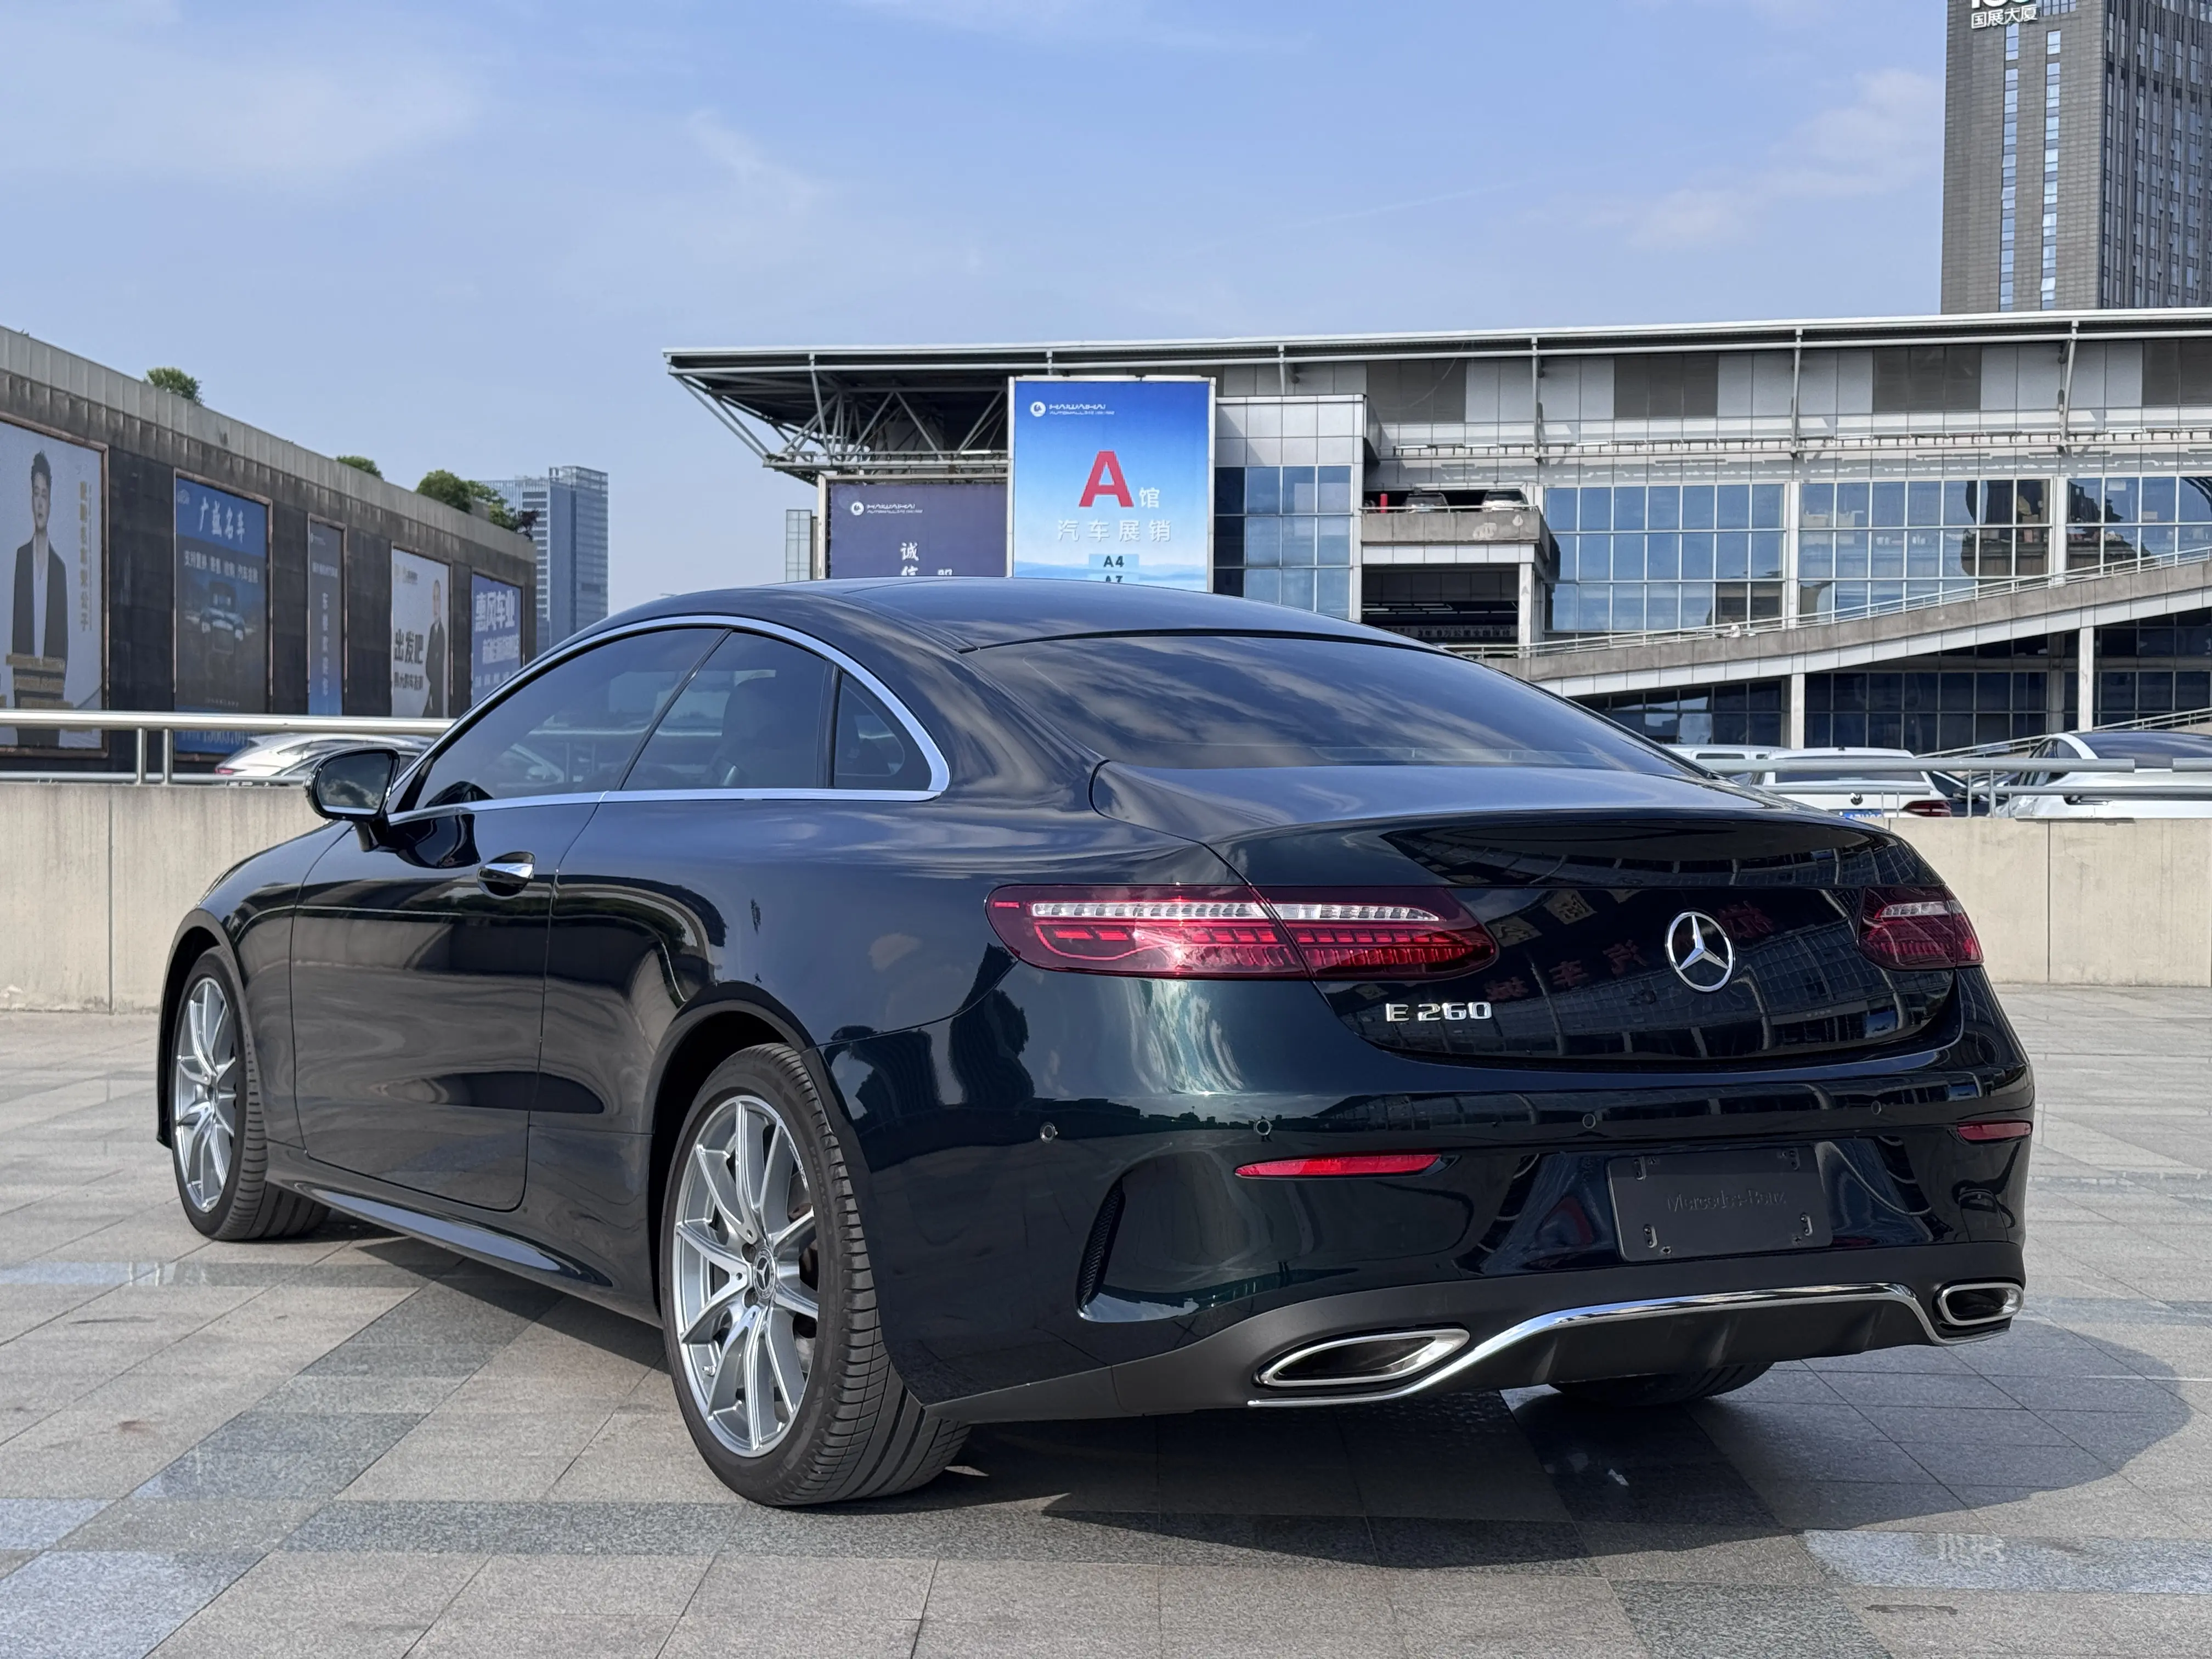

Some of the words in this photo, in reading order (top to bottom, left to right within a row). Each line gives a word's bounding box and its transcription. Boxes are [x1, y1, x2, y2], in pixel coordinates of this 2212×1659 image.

[1971, 4, 2038, 29] 国展大厦
[1057, 519, 1172, 542] 汽车展销
[1103, 555, 1124, 567] A4
[475, 589, 515, 632] 惠风车业
[394, 628, 424, 665] 出发吧
[1386, 1003, 1409, 1022] E
[1418, 1002, 1492, 1021] 260
